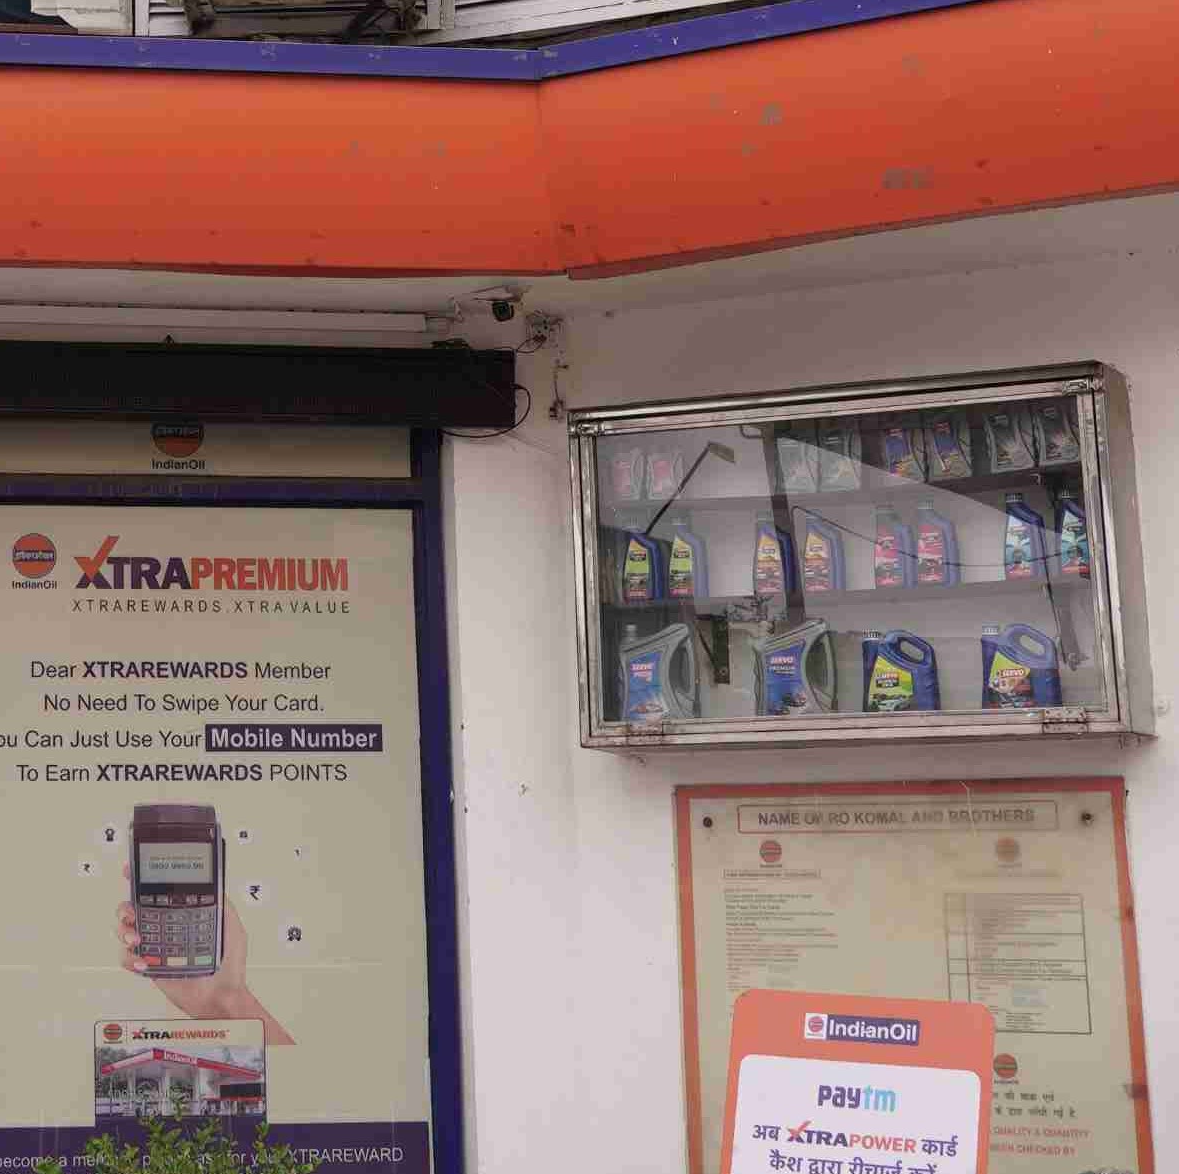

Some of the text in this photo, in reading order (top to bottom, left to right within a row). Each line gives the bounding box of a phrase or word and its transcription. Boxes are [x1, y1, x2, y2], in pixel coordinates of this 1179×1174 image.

[74, 534, 349, 591] XTRAPREMIUM
[12, 581, 58, 590] IndianOil
[31, 661, 331, 679] Dear XTRAREWARDS Member
[44, 694, 324, 714] No Need To Swipe Your Card.
[25, 730, 63, 748] Can
[70, 730, 110, 748] Just
[116, 730, 153, 748] Use
[160, 730, 202, 748] Your
[211, 728, 284, 748] Mobile
[291, 728, 378, 748] Number
[17, 764, 348, 782] To Earn XTRAREWARDS POINTS
[758, 812, 800, 826] NAME
[829, 812, 851, 826] RO
[828, 1019, 918, 1042] IndianOil
[752, 1120, 959, 1157] अब XTRAPOWER कार्ड
[769, 1150, 803, 1172] कैश
